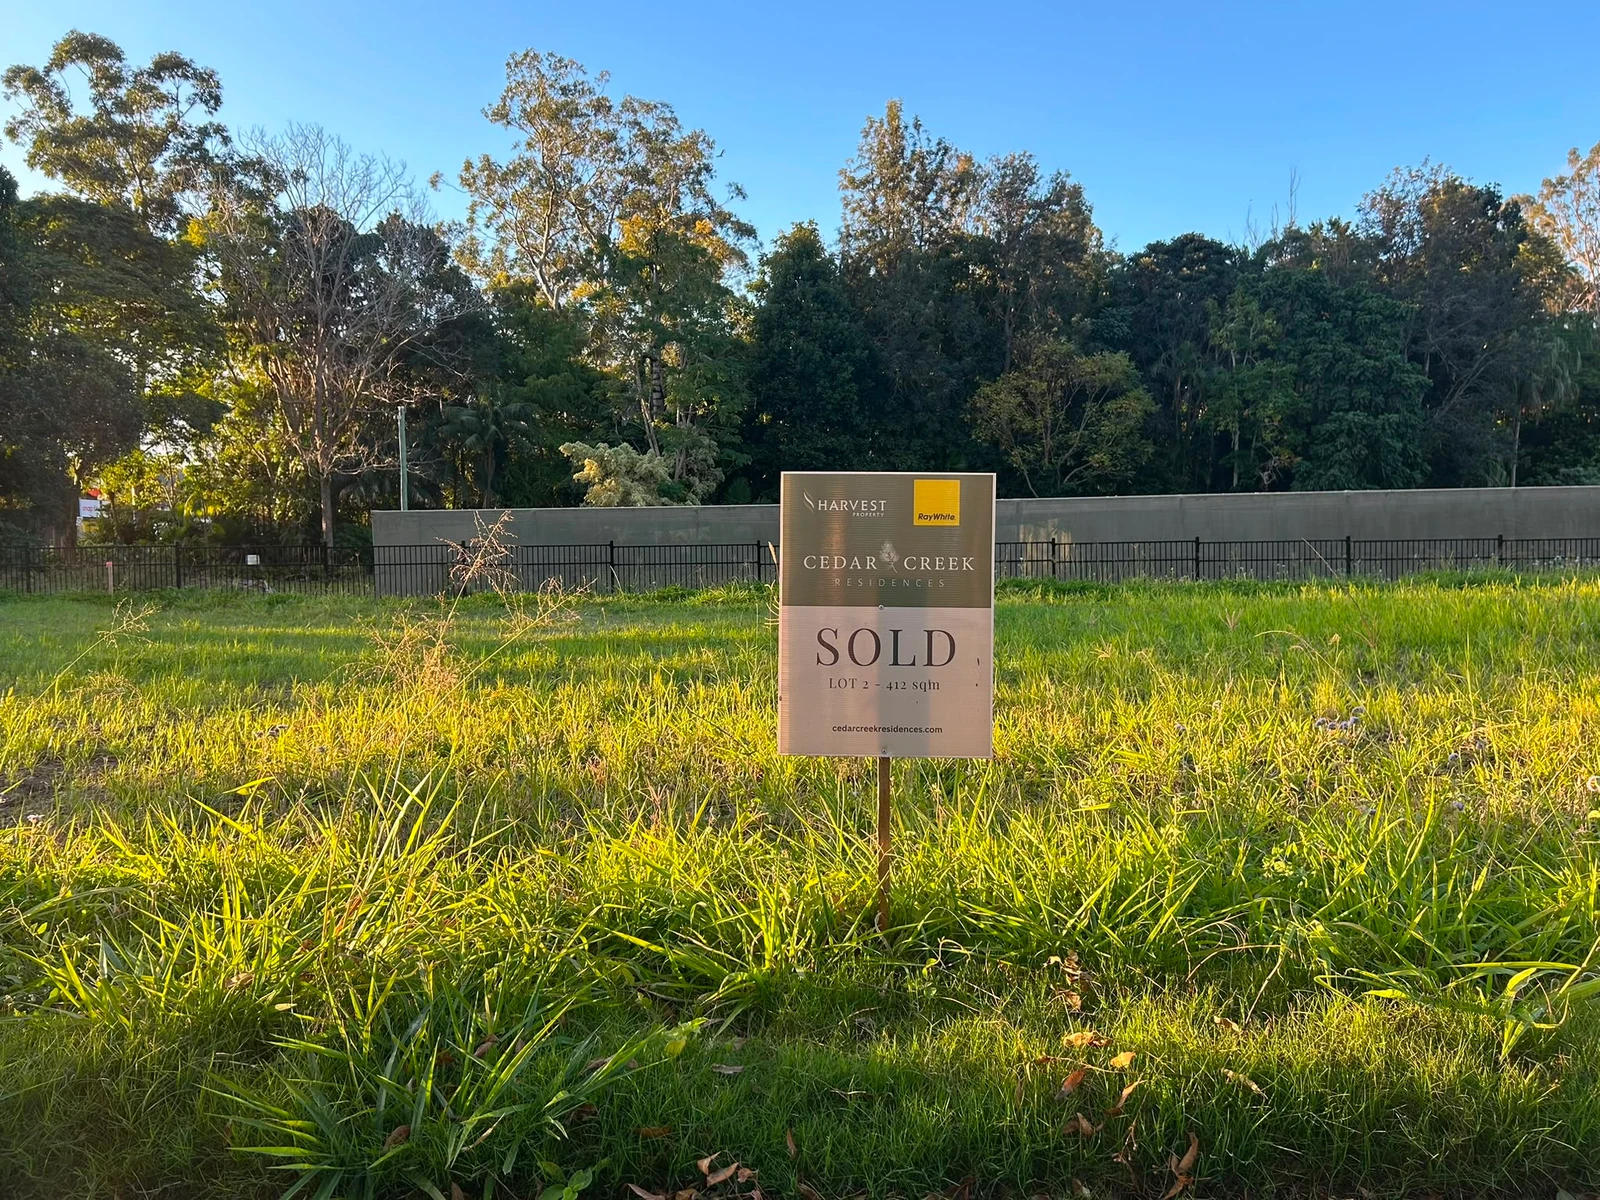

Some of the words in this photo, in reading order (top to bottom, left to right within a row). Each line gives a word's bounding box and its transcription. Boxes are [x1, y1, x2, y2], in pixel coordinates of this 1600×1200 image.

[818, 500, 886, 511] HARVEST
[803, 555, 877, 570] CEDAR
[903, 556, 975, 571] CREEK
[834, 578, 945, 587] RESIDENCES
[816, 628, 956, 667] SOLD
[828, 678, 857, 689] LOT
[862, 681, 869, 689] 2
[886, 681, 907, 691] 412
[912, 679, 940, 692] sqm
[832, 725, 943, 733] cedarcreekresidences.com
